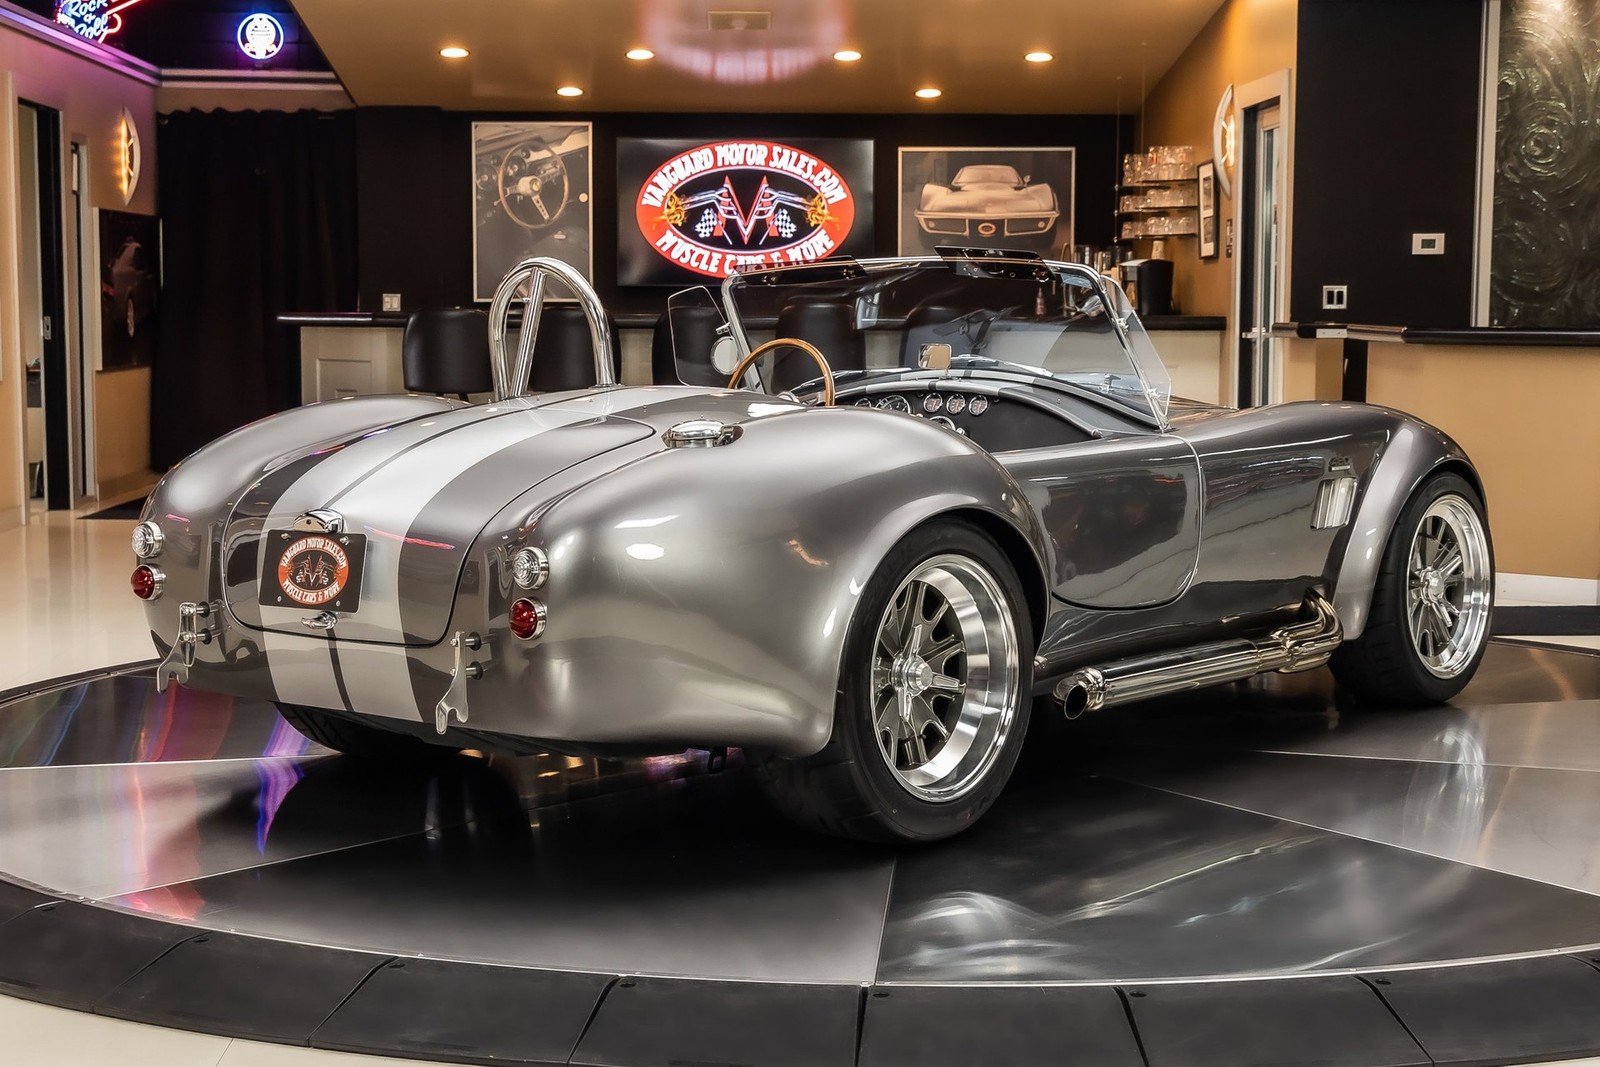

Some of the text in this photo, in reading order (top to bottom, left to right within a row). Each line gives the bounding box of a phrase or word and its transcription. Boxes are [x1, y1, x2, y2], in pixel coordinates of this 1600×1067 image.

[69, 0, 109, 18] Rock
[641, 143, 848, 208] VANGUARD MOTOR SALES.COM
[655, 230, 724, 273] MUSCLE
[786, 229, 835, 266] MORE
[280, 538, 347, 569] VANGUARD MOTOR SALES.COM
[282, 578, 304, 601] MUSCLE
[302, 591, 318, 603] CARS
[323, 581, 341, 600] MORE
